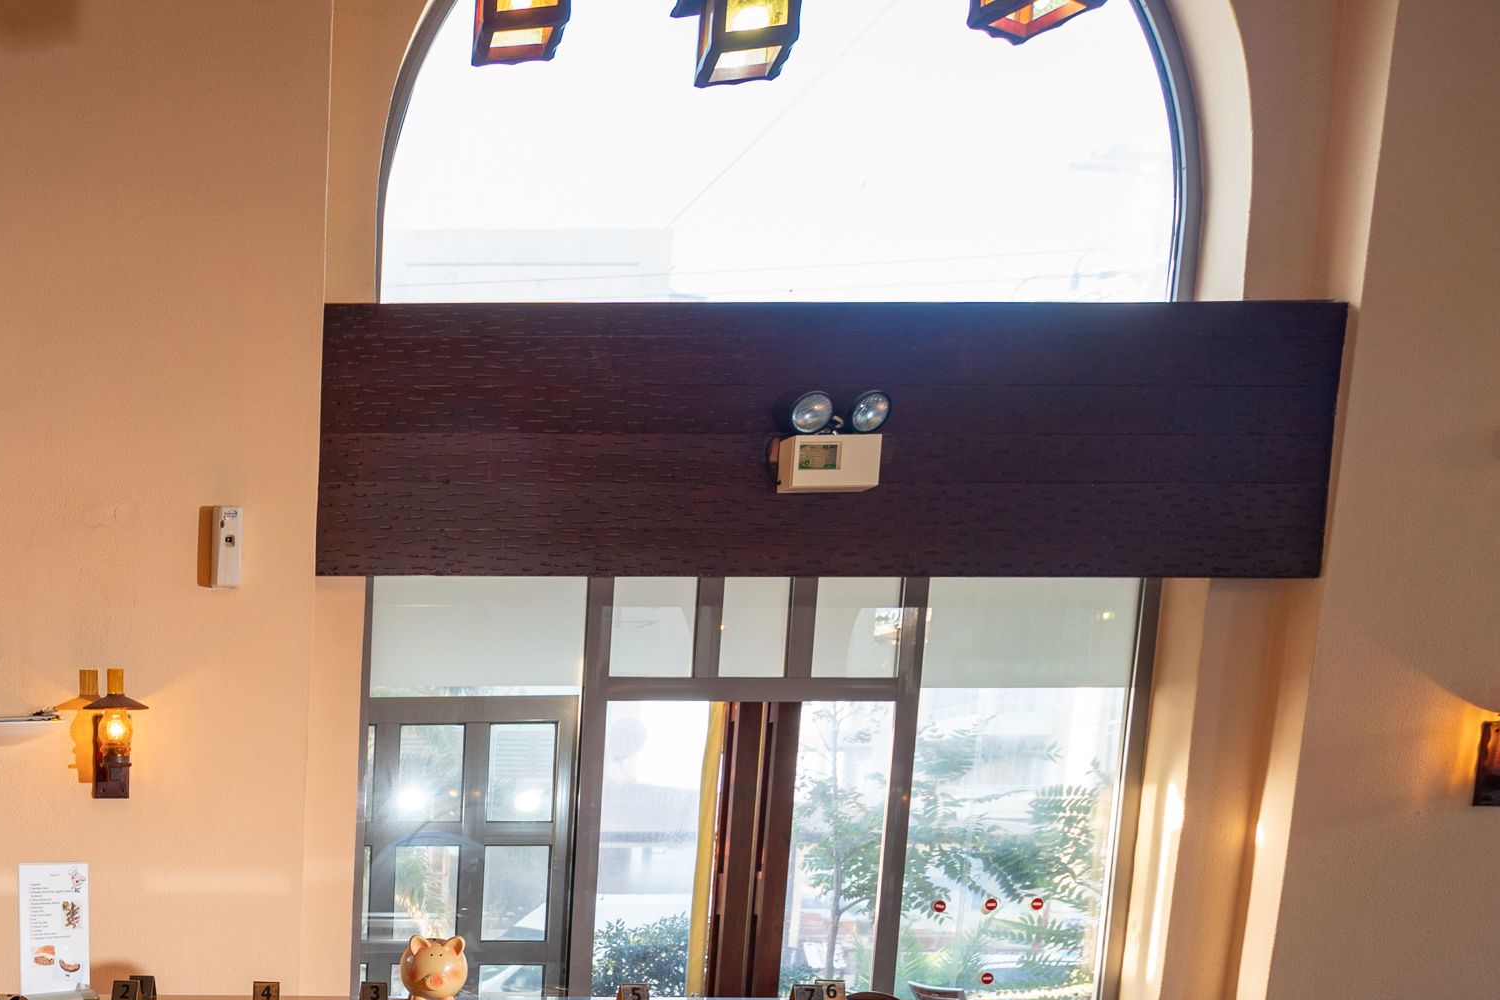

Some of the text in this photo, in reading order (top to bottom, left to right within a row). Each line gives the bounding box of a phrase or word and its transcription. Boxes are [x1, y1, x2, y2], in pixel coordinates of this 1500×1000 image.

[120, 984, 130, 1000] 2
[261, 985, 272, 1000] 4
[370, 985, 380, 1000] 3
[826, 983, 837, 999] 6
